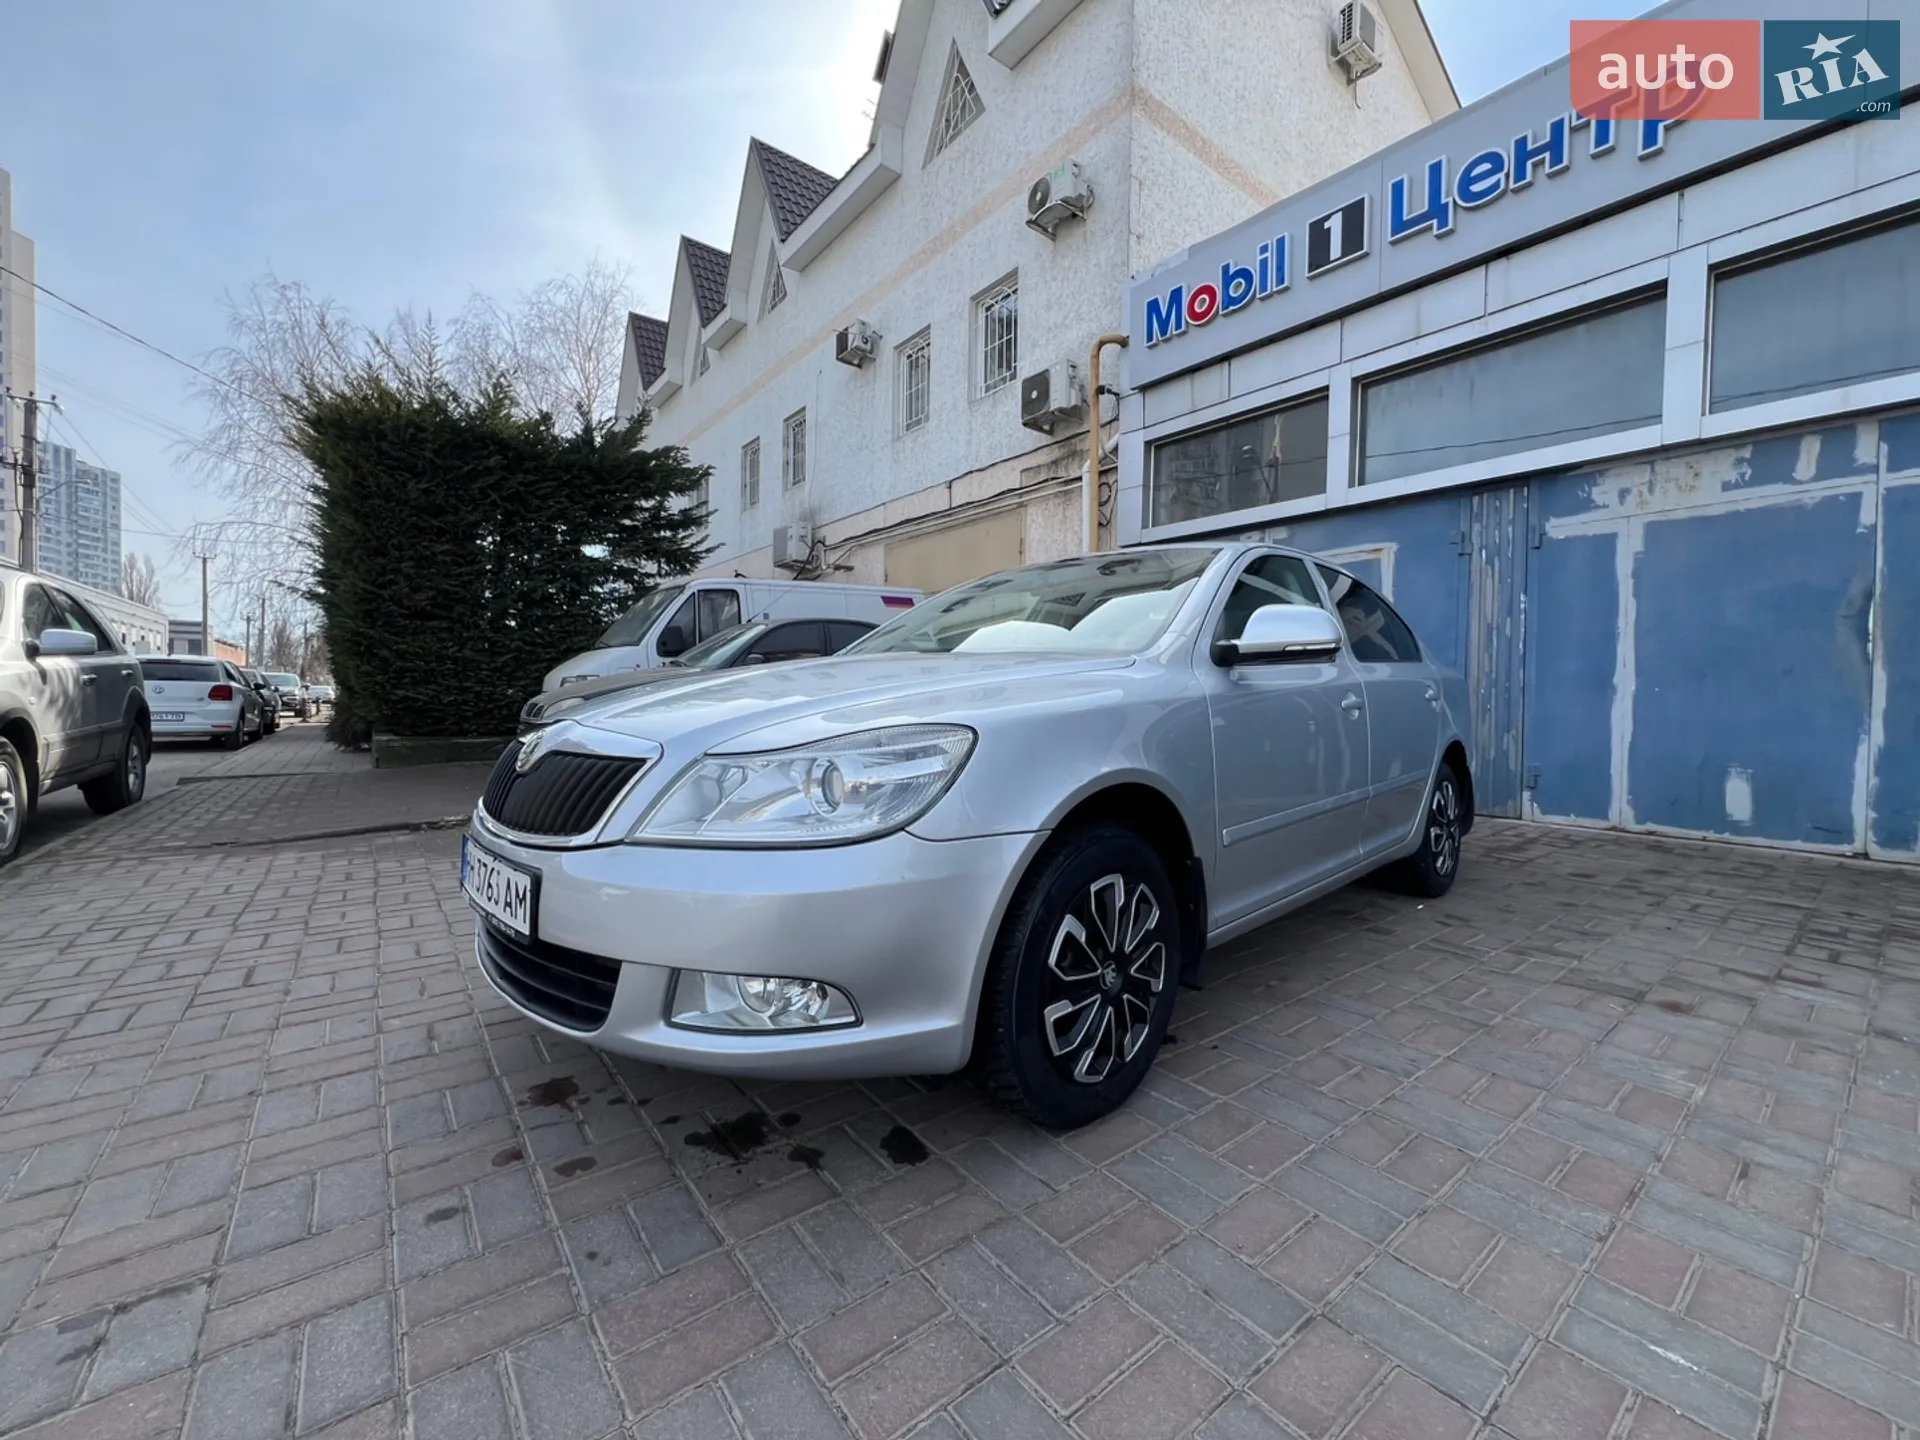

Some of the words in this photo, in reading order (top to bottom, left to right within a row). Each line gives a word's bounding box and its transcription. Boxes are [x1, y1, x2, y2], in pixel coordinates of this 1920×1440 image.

[1145, 232, 1291, 348] Mobil
[1324, 210, 1343, 262] 1
[503, 877, 528, 924] AM
